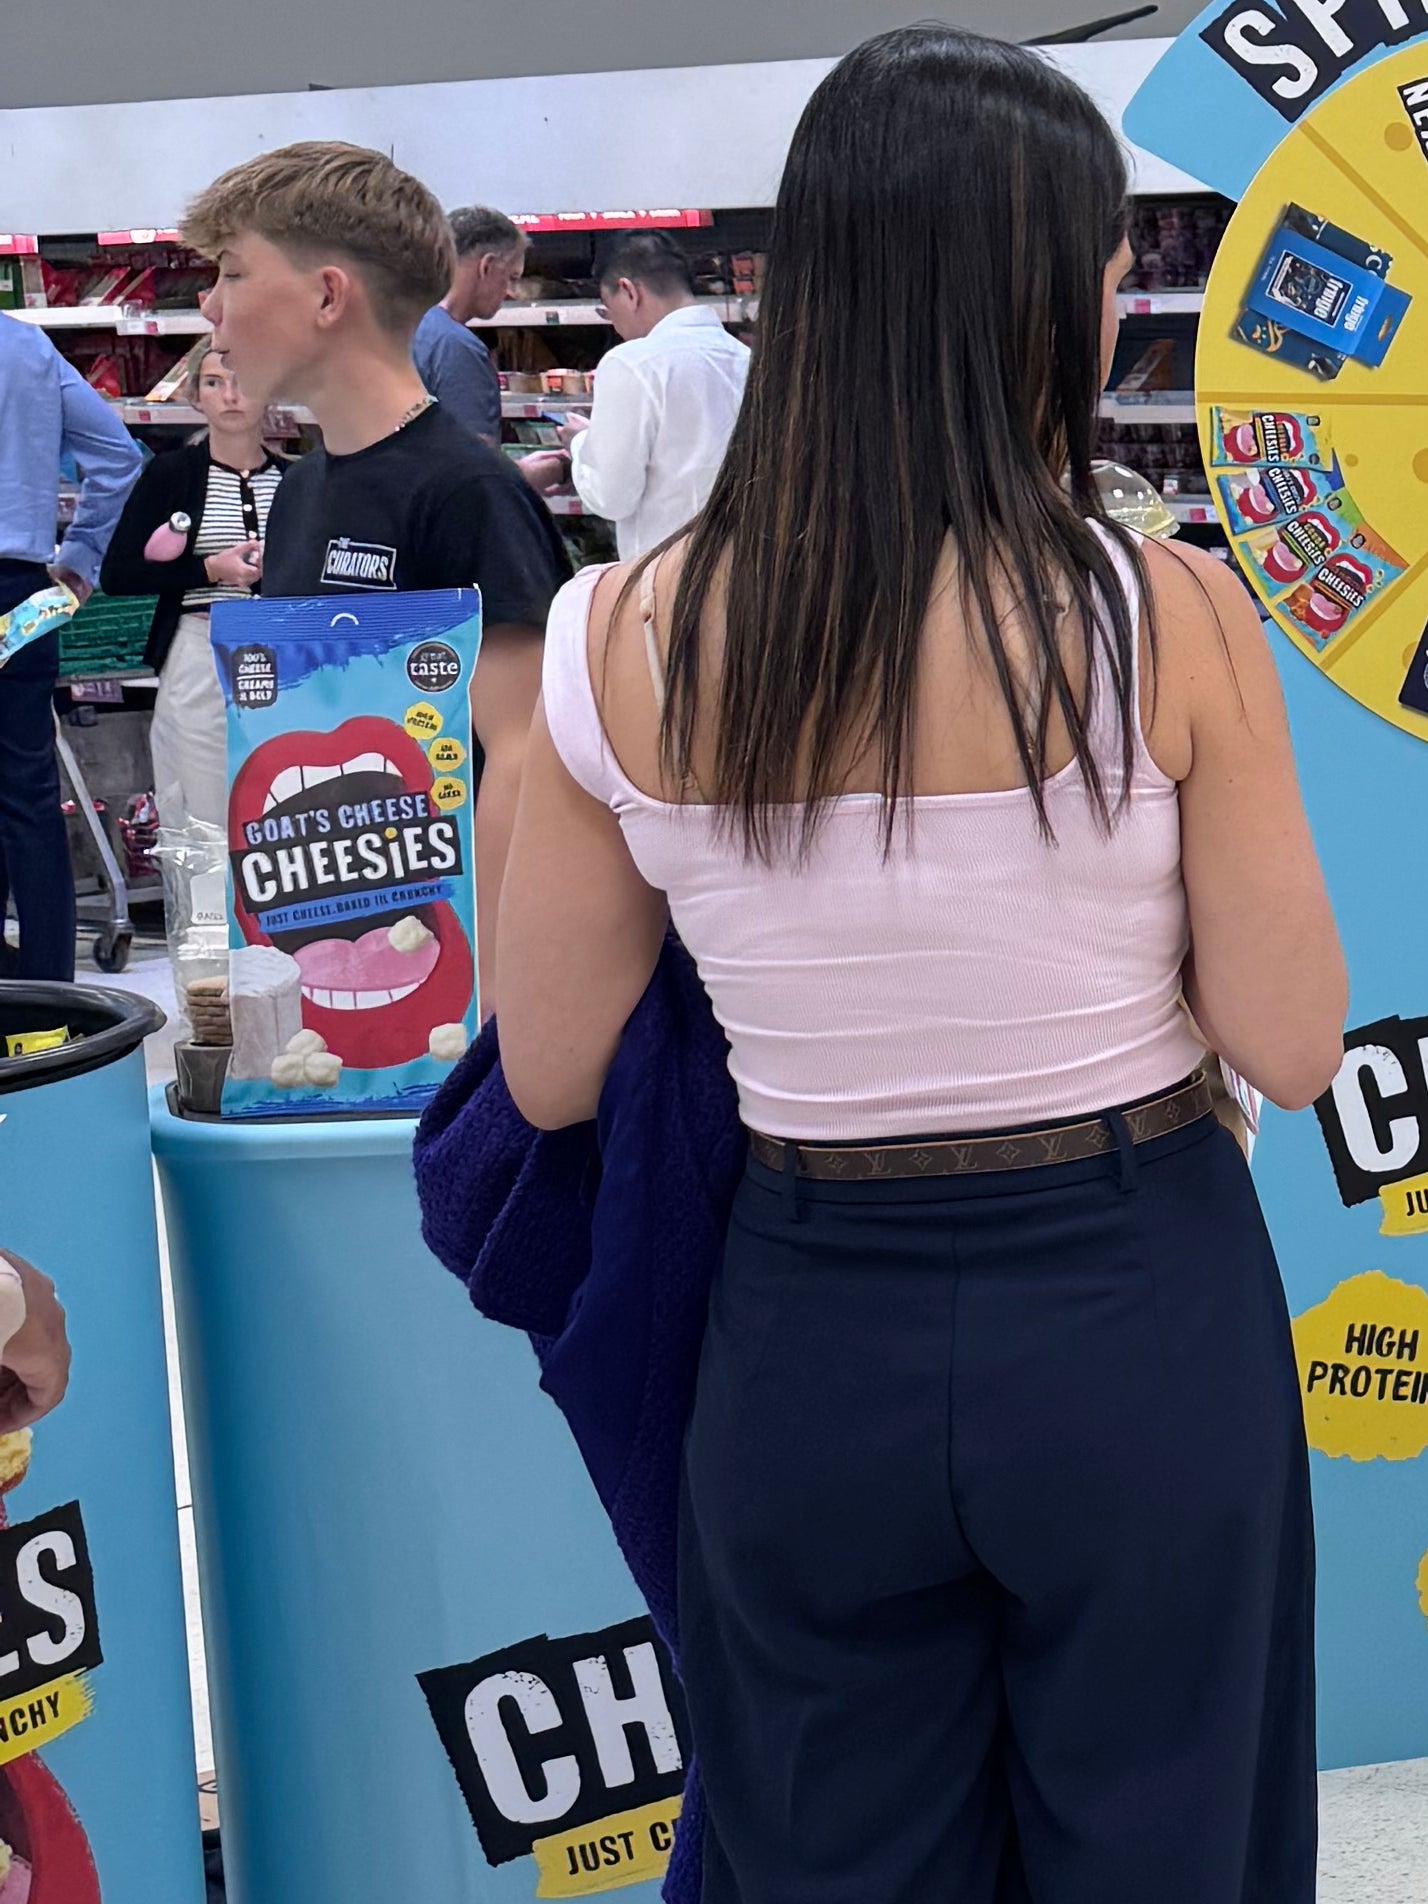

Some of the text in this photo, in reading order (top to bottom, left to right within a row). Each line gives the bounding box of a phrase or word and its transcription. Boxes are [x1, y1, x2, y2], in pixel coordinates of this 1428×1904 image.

[327, 550, 389, 581] CURATORS
[410, 661, 458, 676] taste
[246, 794, 428, 845] GOAT'S CHEESE
[266, 911, 289, 927] JUST
[337, 899, 371, 913] BAKED
[374, 894, 388, 907] TIL
[391, 884, 442, 902] CRUNCHY
[1344, 1323, 1420, 1364] HIGH
[566, 1830, 635, 1876] JUST
